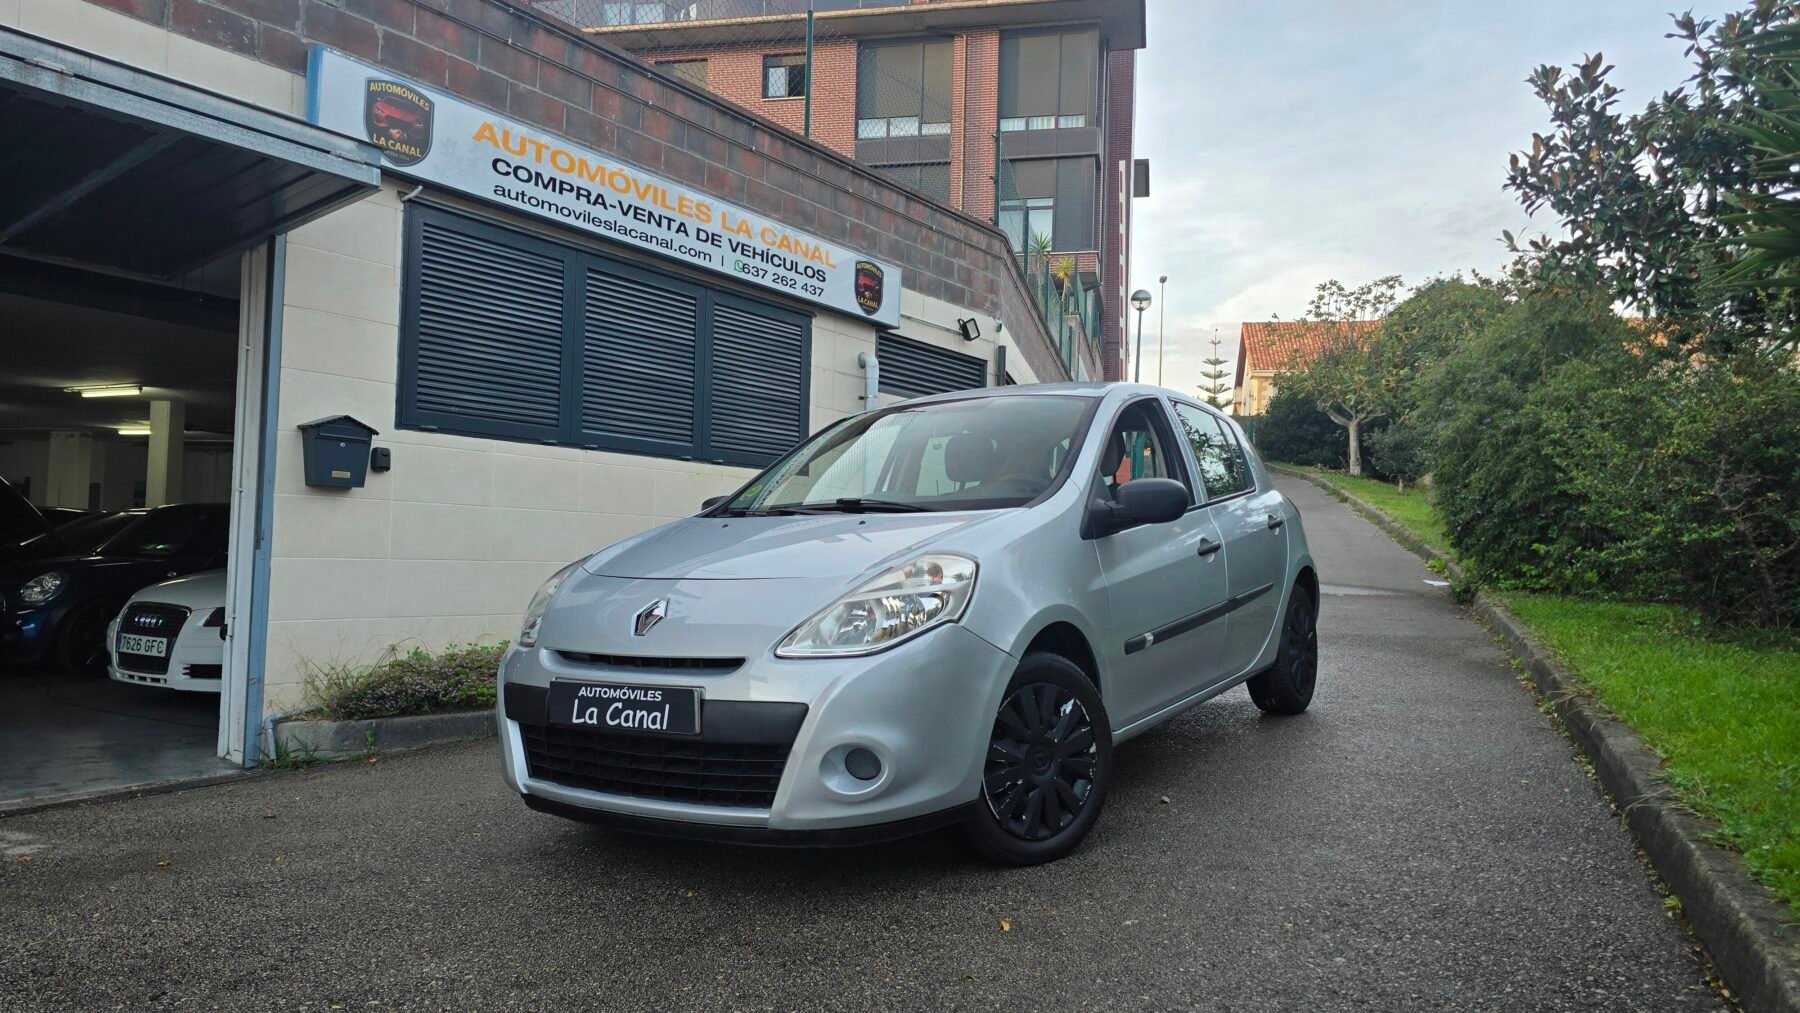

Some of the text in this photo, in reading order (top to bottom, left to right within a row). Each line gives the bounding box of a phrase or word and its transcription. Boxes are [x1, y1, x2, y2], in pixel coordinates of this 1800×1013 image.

[370, 82, 430, 111] AUTOMÓVILES
[373, 133, 386, 147] LA
[388, 140, 422, 157] CANAL
[472, 122, 837, 269] AUTOMÓVILES LA CANAL
[491, 158, 827, 283] COMPRA-VENTA DE VEHÍCULOS
[493, 184, 712, 262] automovileslacanal.com
[742, 263, 768, 280] 637
[772, 273, 797, 289] 262
[801, 283, 824, 297] 437
[121, 635, 164, 654] 7626 GFC
[578, 686, 663, 702] AUTOMÓVILES
[572, 698, 670, 730] La Canal
